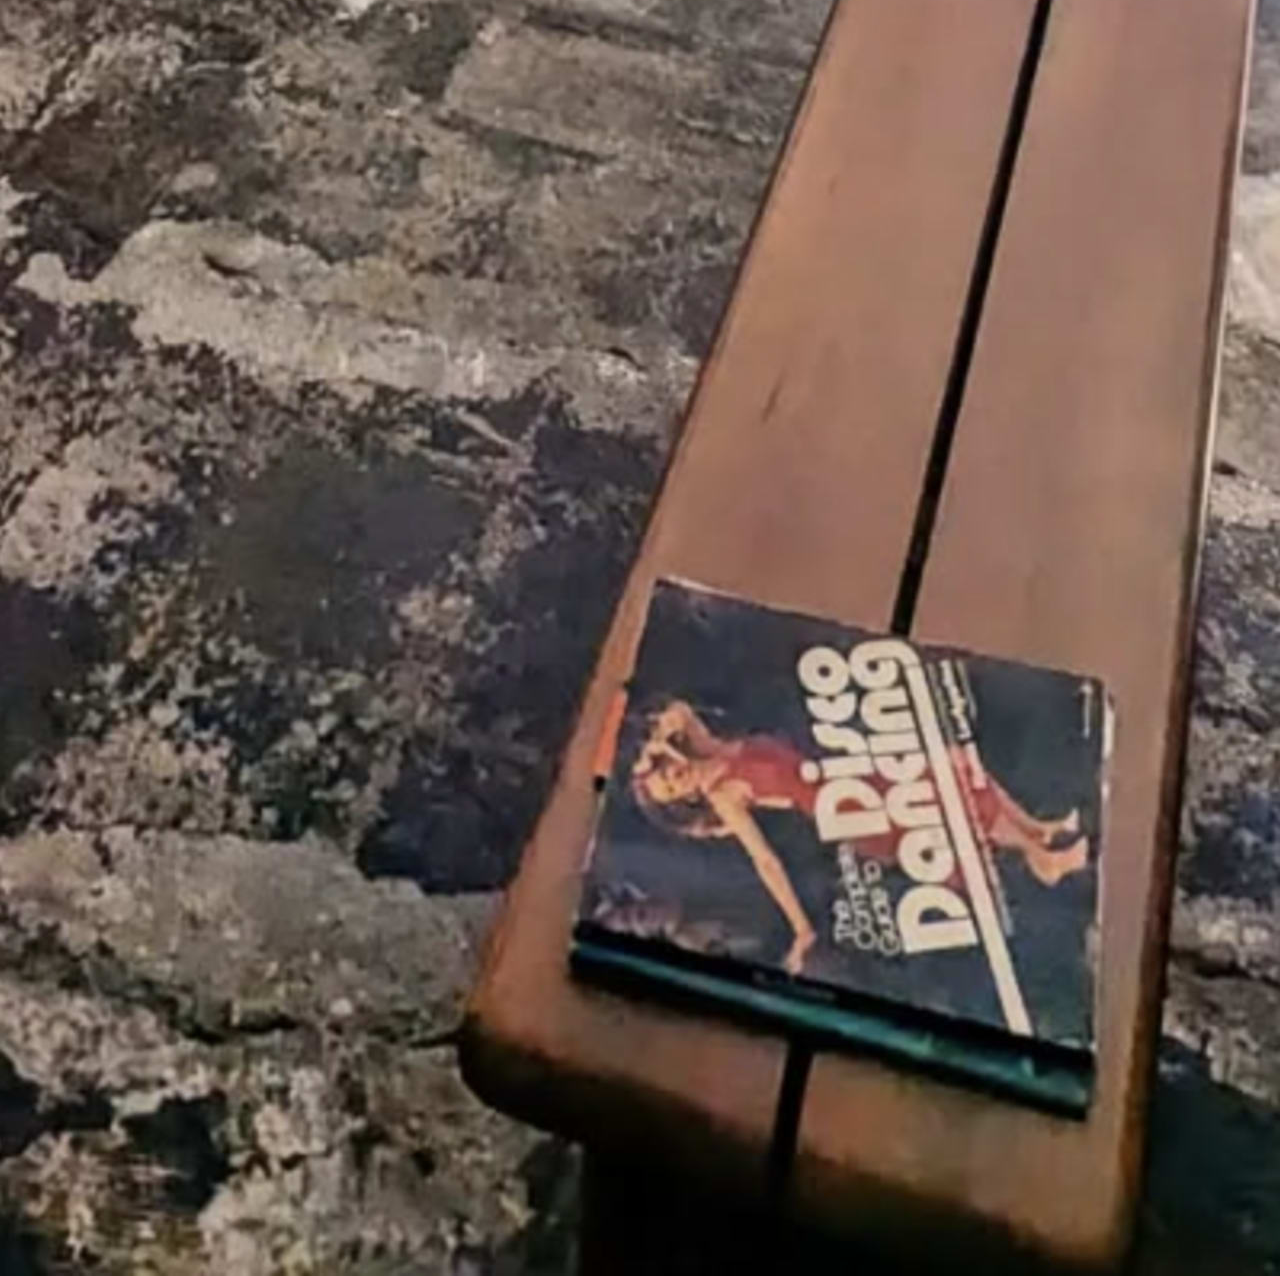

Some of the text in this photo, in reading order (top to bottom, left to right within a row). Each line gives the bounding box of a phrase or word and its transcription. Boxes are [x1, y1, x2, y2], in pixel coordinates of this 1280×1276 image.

[797, 645, 893, 843] Disco
[847, 638, 980, 955] Dancing
[832, 899, 854, 944] The
